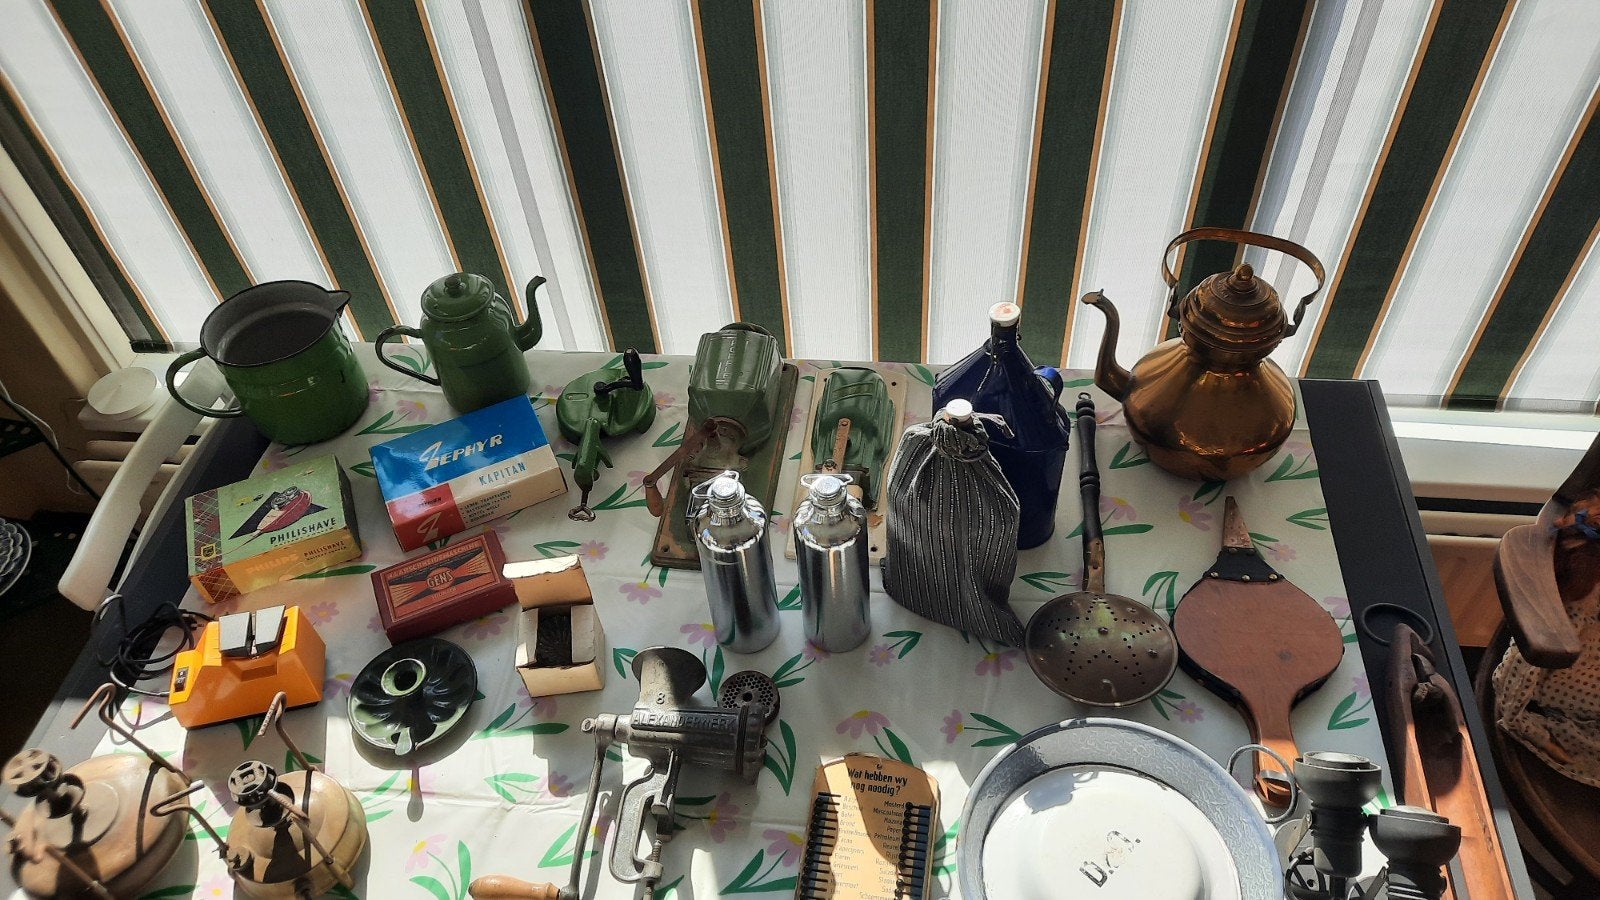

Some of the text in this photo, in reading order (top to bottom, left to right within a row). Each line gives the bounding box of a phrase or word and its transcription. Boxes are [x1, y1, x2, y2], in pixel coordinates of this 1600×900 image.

[419, 434, 503, 471] ZEPHYR
[479, 462, 527, 486] KAPITAN
[270, 517, 337, 545] PHILISHAVE
[303, 541, 345, 557] PHILISHAVE
[427, 570, 453, 588] GENS
[656, 692, 665, 705] 8
[632, 711, 735, 728] ALEXANDERWERK
[848, 768, 862, 779] Wat
[865, 770, 893, 783] hebben
[851, 782, 901, 797] nog noodig?
